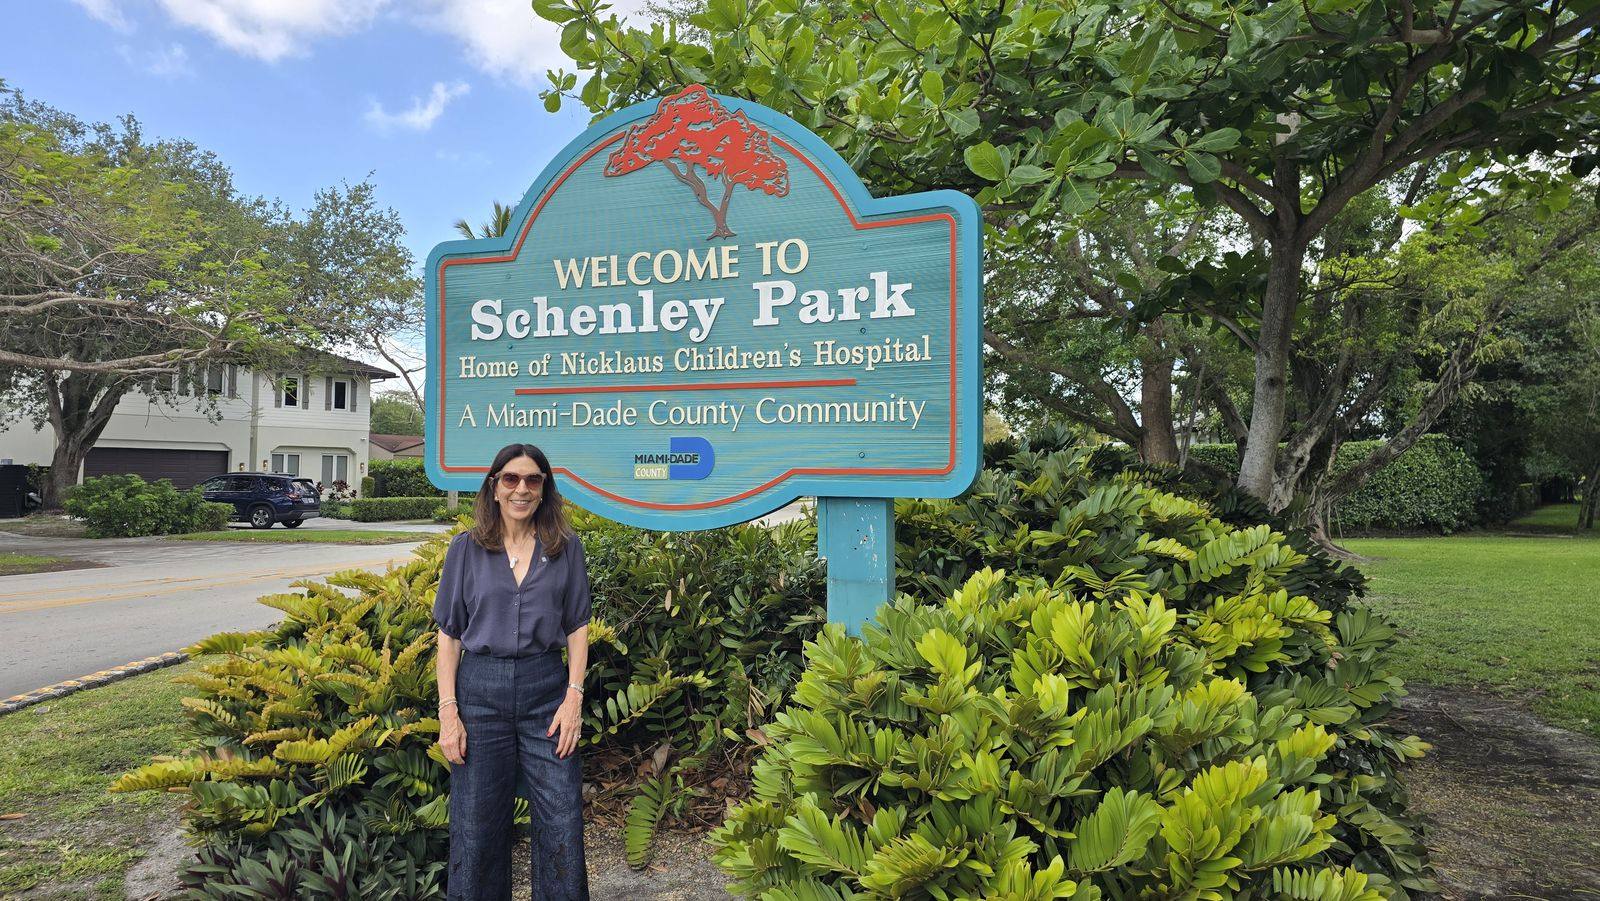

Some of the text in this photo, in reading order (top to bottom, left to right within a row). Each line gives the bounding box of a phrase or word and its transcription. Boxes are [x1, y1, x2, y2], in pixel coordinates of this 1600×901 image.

[553, 238, 810, 290] WELCOME TO
[471, 271, 916, 343] Schenley Park
[459, 335, 932, 379] Home of Nicklaus Children's Hospital
[458, 393, 926, 432] A Miami-Dade County Community
[635, 467, 667, 477] COUNTY
